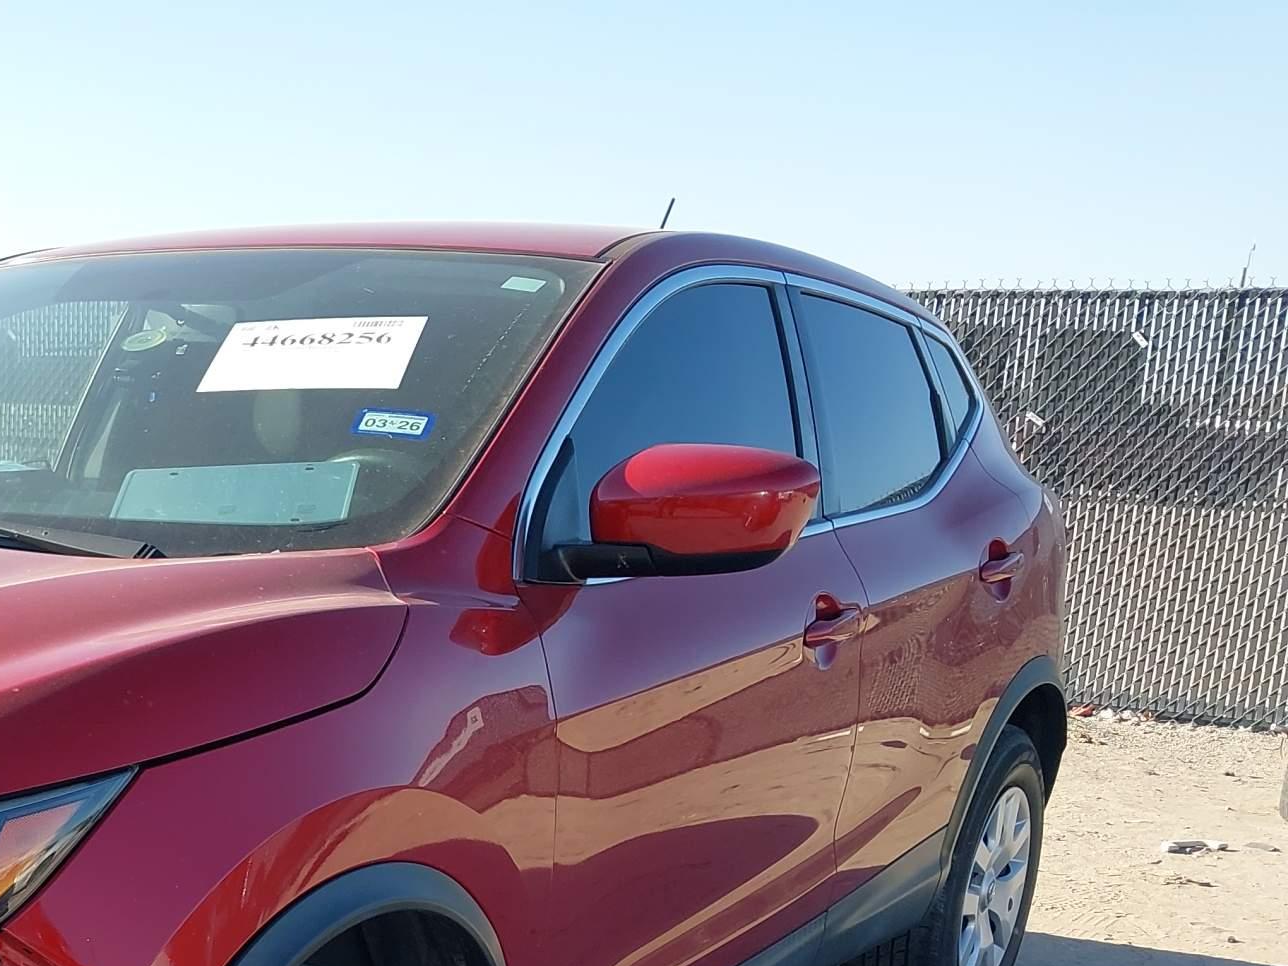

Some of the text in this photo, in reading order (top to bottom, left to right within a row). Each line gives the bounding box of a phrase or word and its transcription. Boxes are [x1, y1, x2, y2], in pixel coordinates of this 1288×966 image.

[242, 331, 393, 348] 44668256
[364, 418, 422, 432] 03 26
